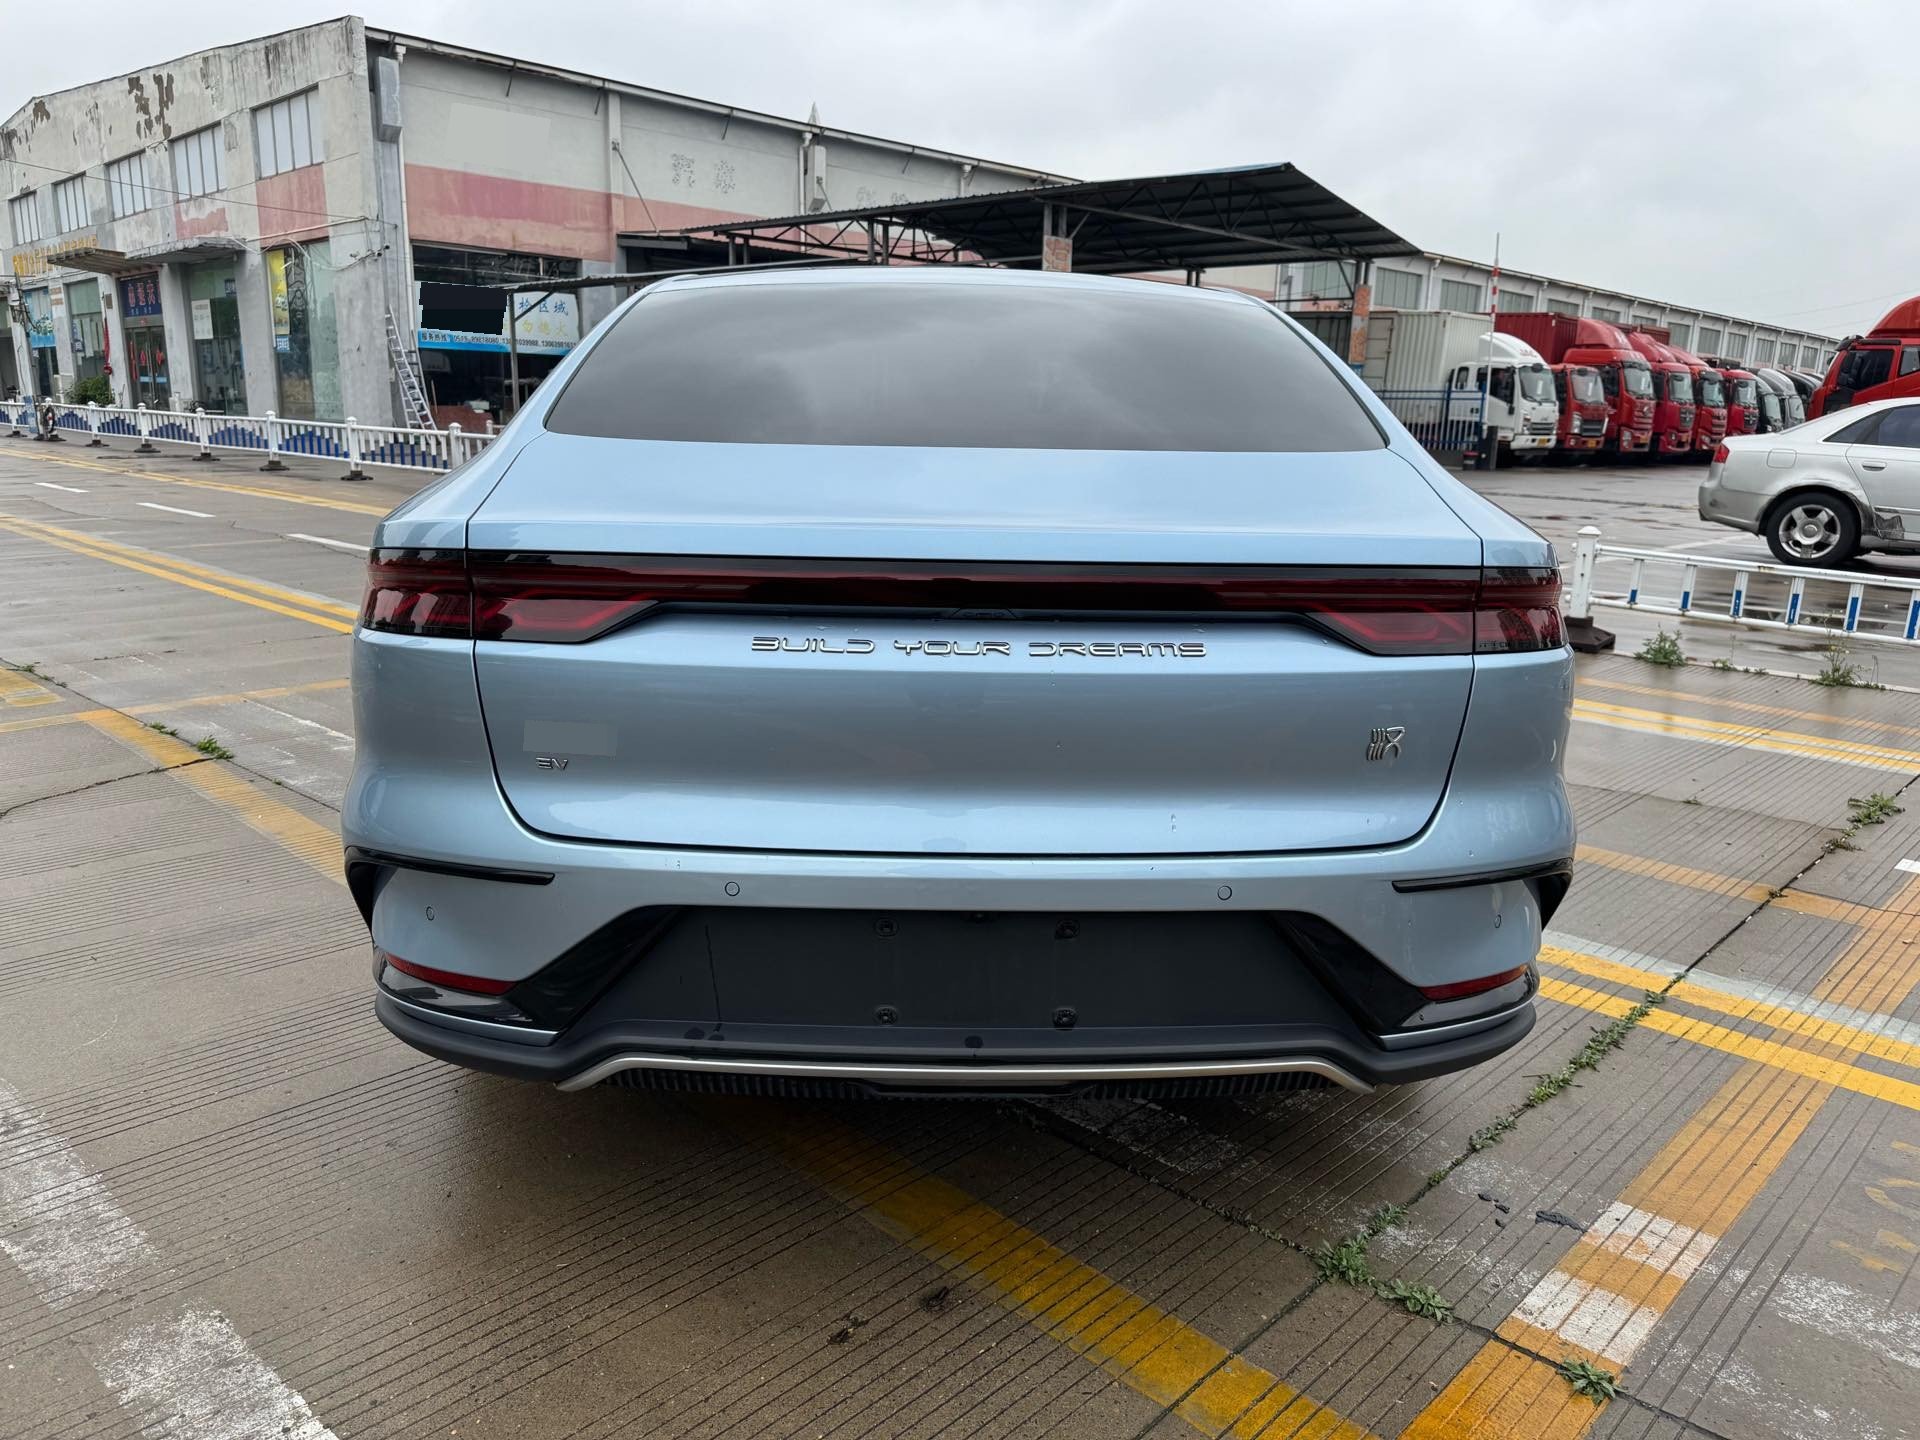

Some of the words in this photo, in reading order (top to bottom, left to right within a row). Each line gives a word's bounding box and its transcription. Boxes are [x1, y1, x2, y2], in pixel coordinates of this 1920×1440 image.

[751, 636, 876, 653] BUILD
[894, 639, 1011, 656] YOUR
[1029, 642, 1207, 658] DREAMS
[535, 757, 568, 771] EV
